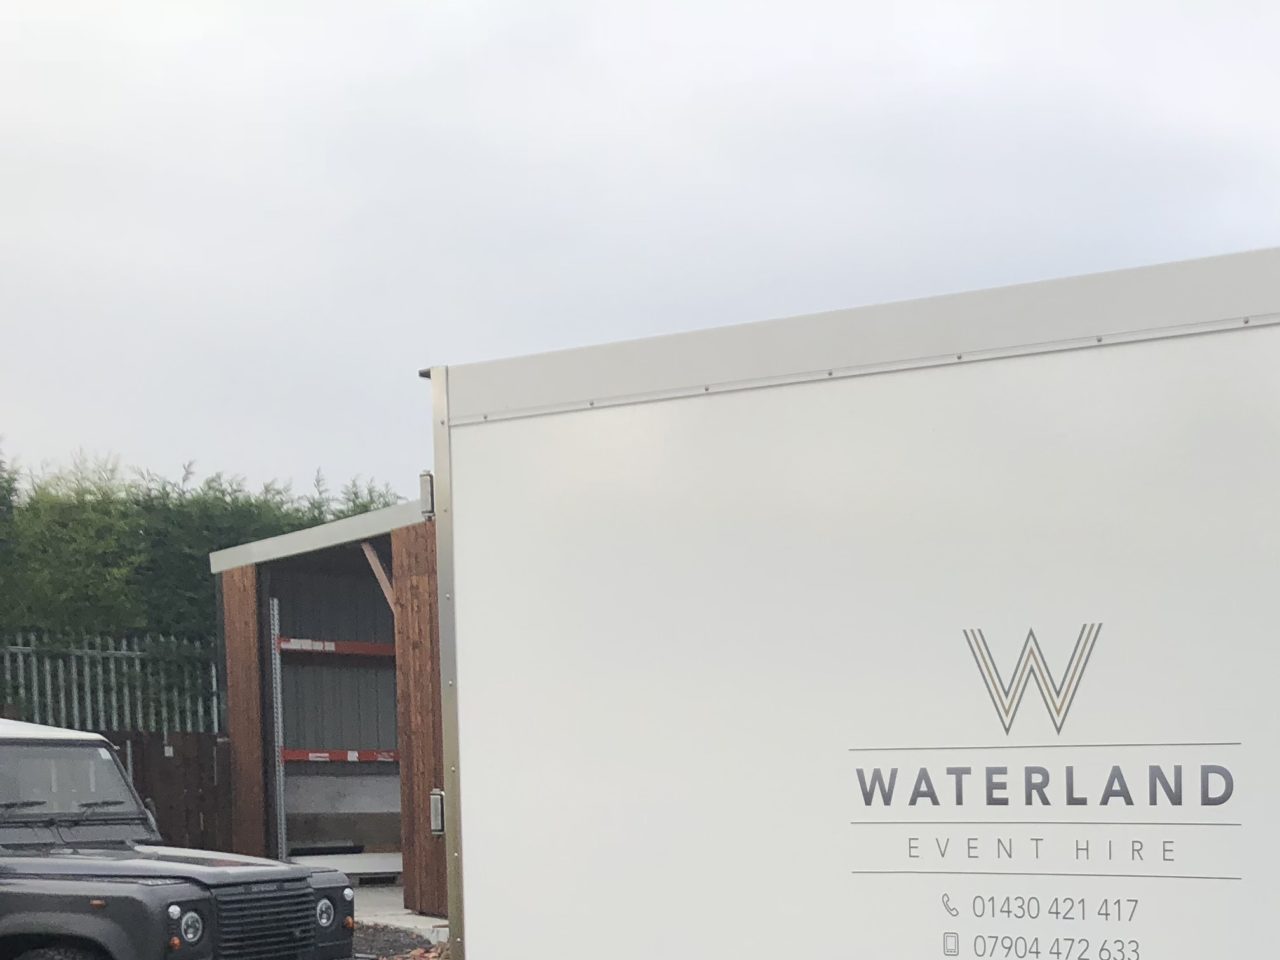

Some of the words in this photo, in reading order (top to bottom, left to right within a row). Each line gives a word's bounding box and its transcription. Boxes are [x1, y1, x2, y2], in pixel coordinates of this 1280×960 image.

[962, 623, 1103, 736] W
[856, 765, 1235, 806] WATERLAND
[908, 838, 1045, 860] EVENT
[1075, 840, 1175, 862] HIRE
[972, 895, 1041, 920] 01430
[1047, 897, 1087, 921] 421
[1097, 899, 1139, 922] 417
[973, 935, 1042, 960] 07904
